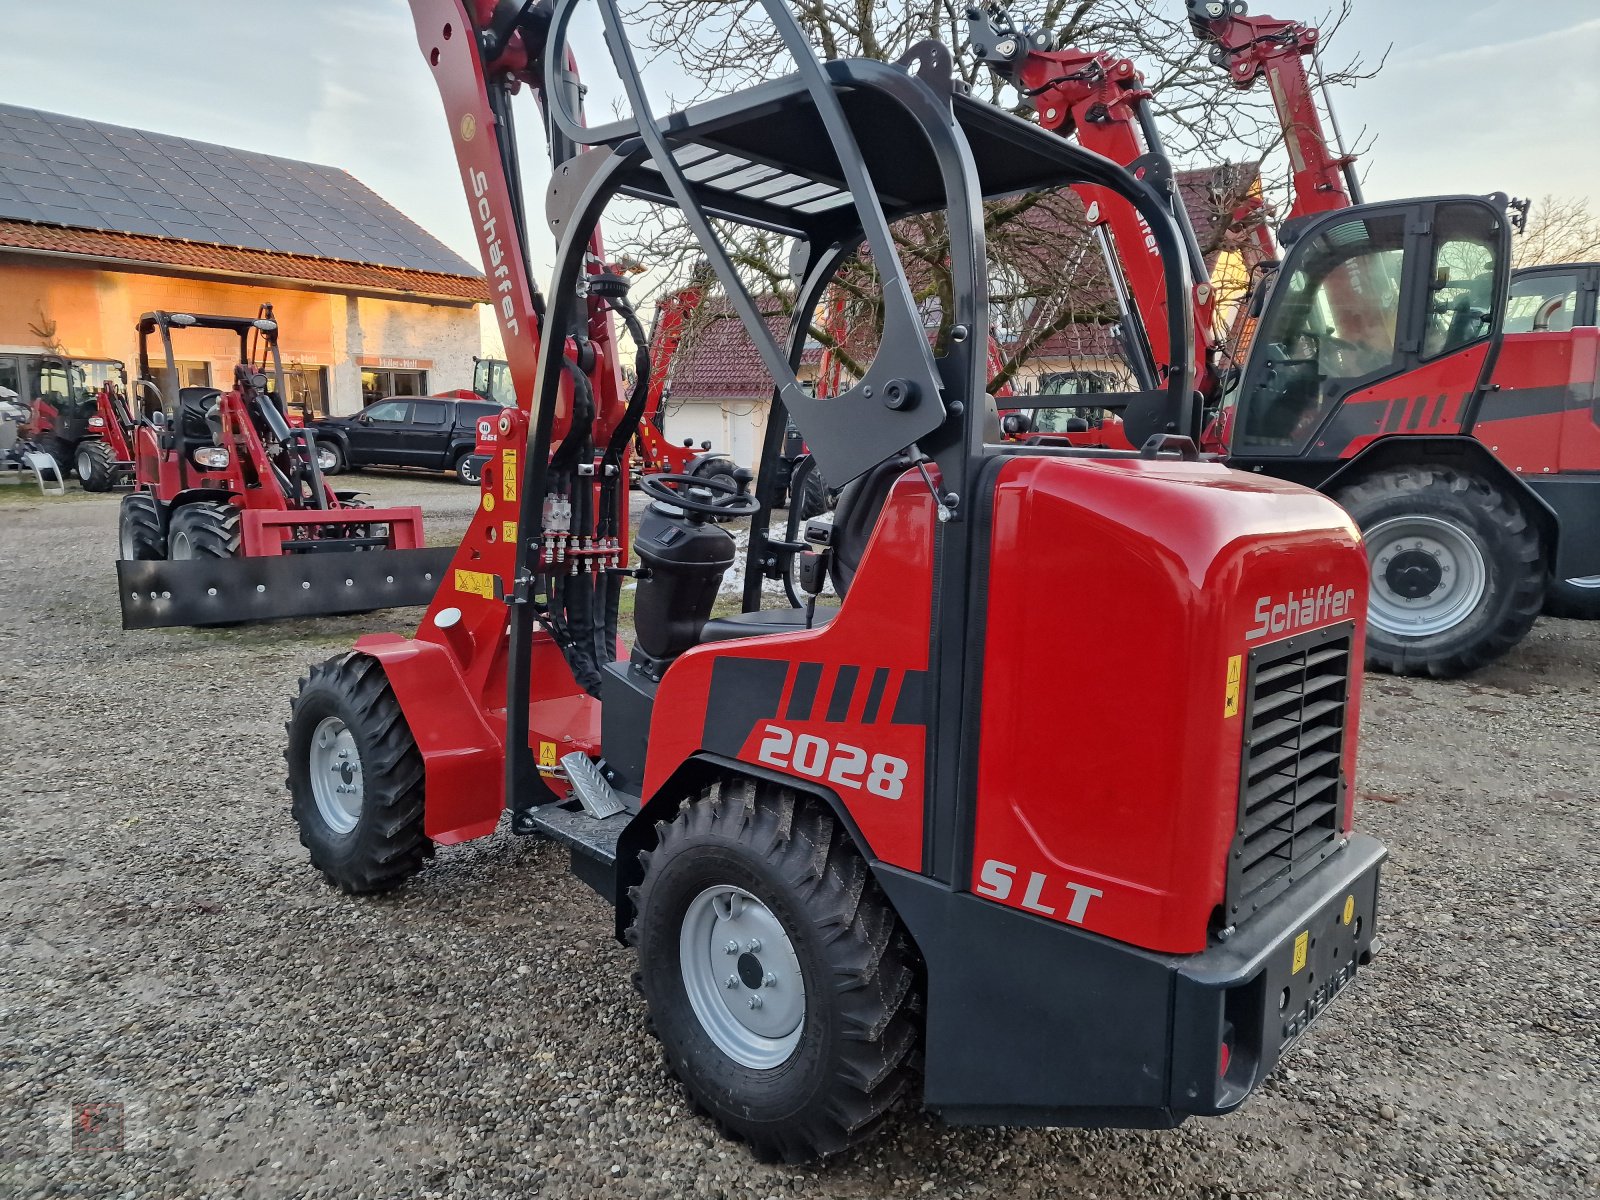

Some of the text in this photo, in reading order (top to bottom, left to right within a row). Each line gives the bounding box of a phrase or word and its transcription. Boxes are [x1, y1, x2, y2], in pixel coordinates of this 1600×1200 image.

[469, 166, 519, 336] Schäffer
[1245, 584, 1355, 640] Schäffer
[758, 724, 909, 801] 2028
[976, 859, 1104, 924] SLT
